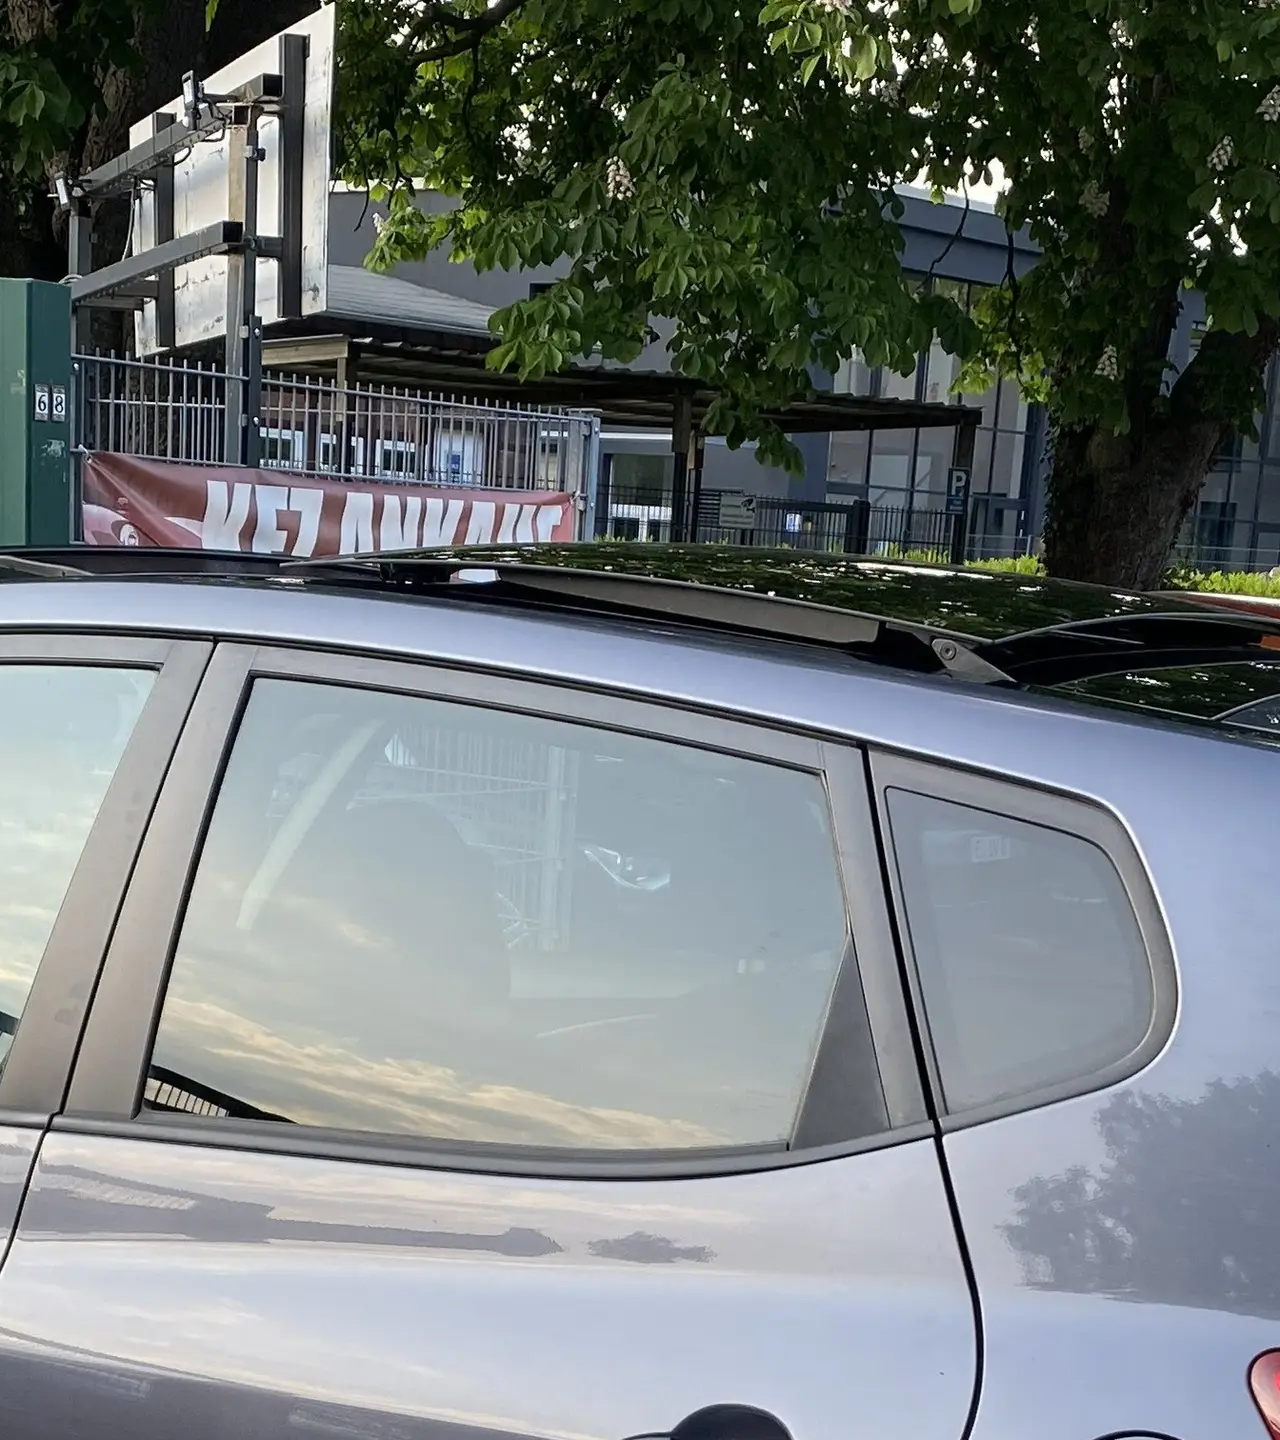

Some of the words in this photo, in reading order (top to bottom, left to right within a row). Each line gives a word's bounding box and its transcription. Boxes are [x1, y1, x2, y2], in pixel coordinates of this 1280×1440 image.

[37, 394, 64, 414] 68
[951, 470, 967, 496] P
[201, 480, 324, 558] KFZ
